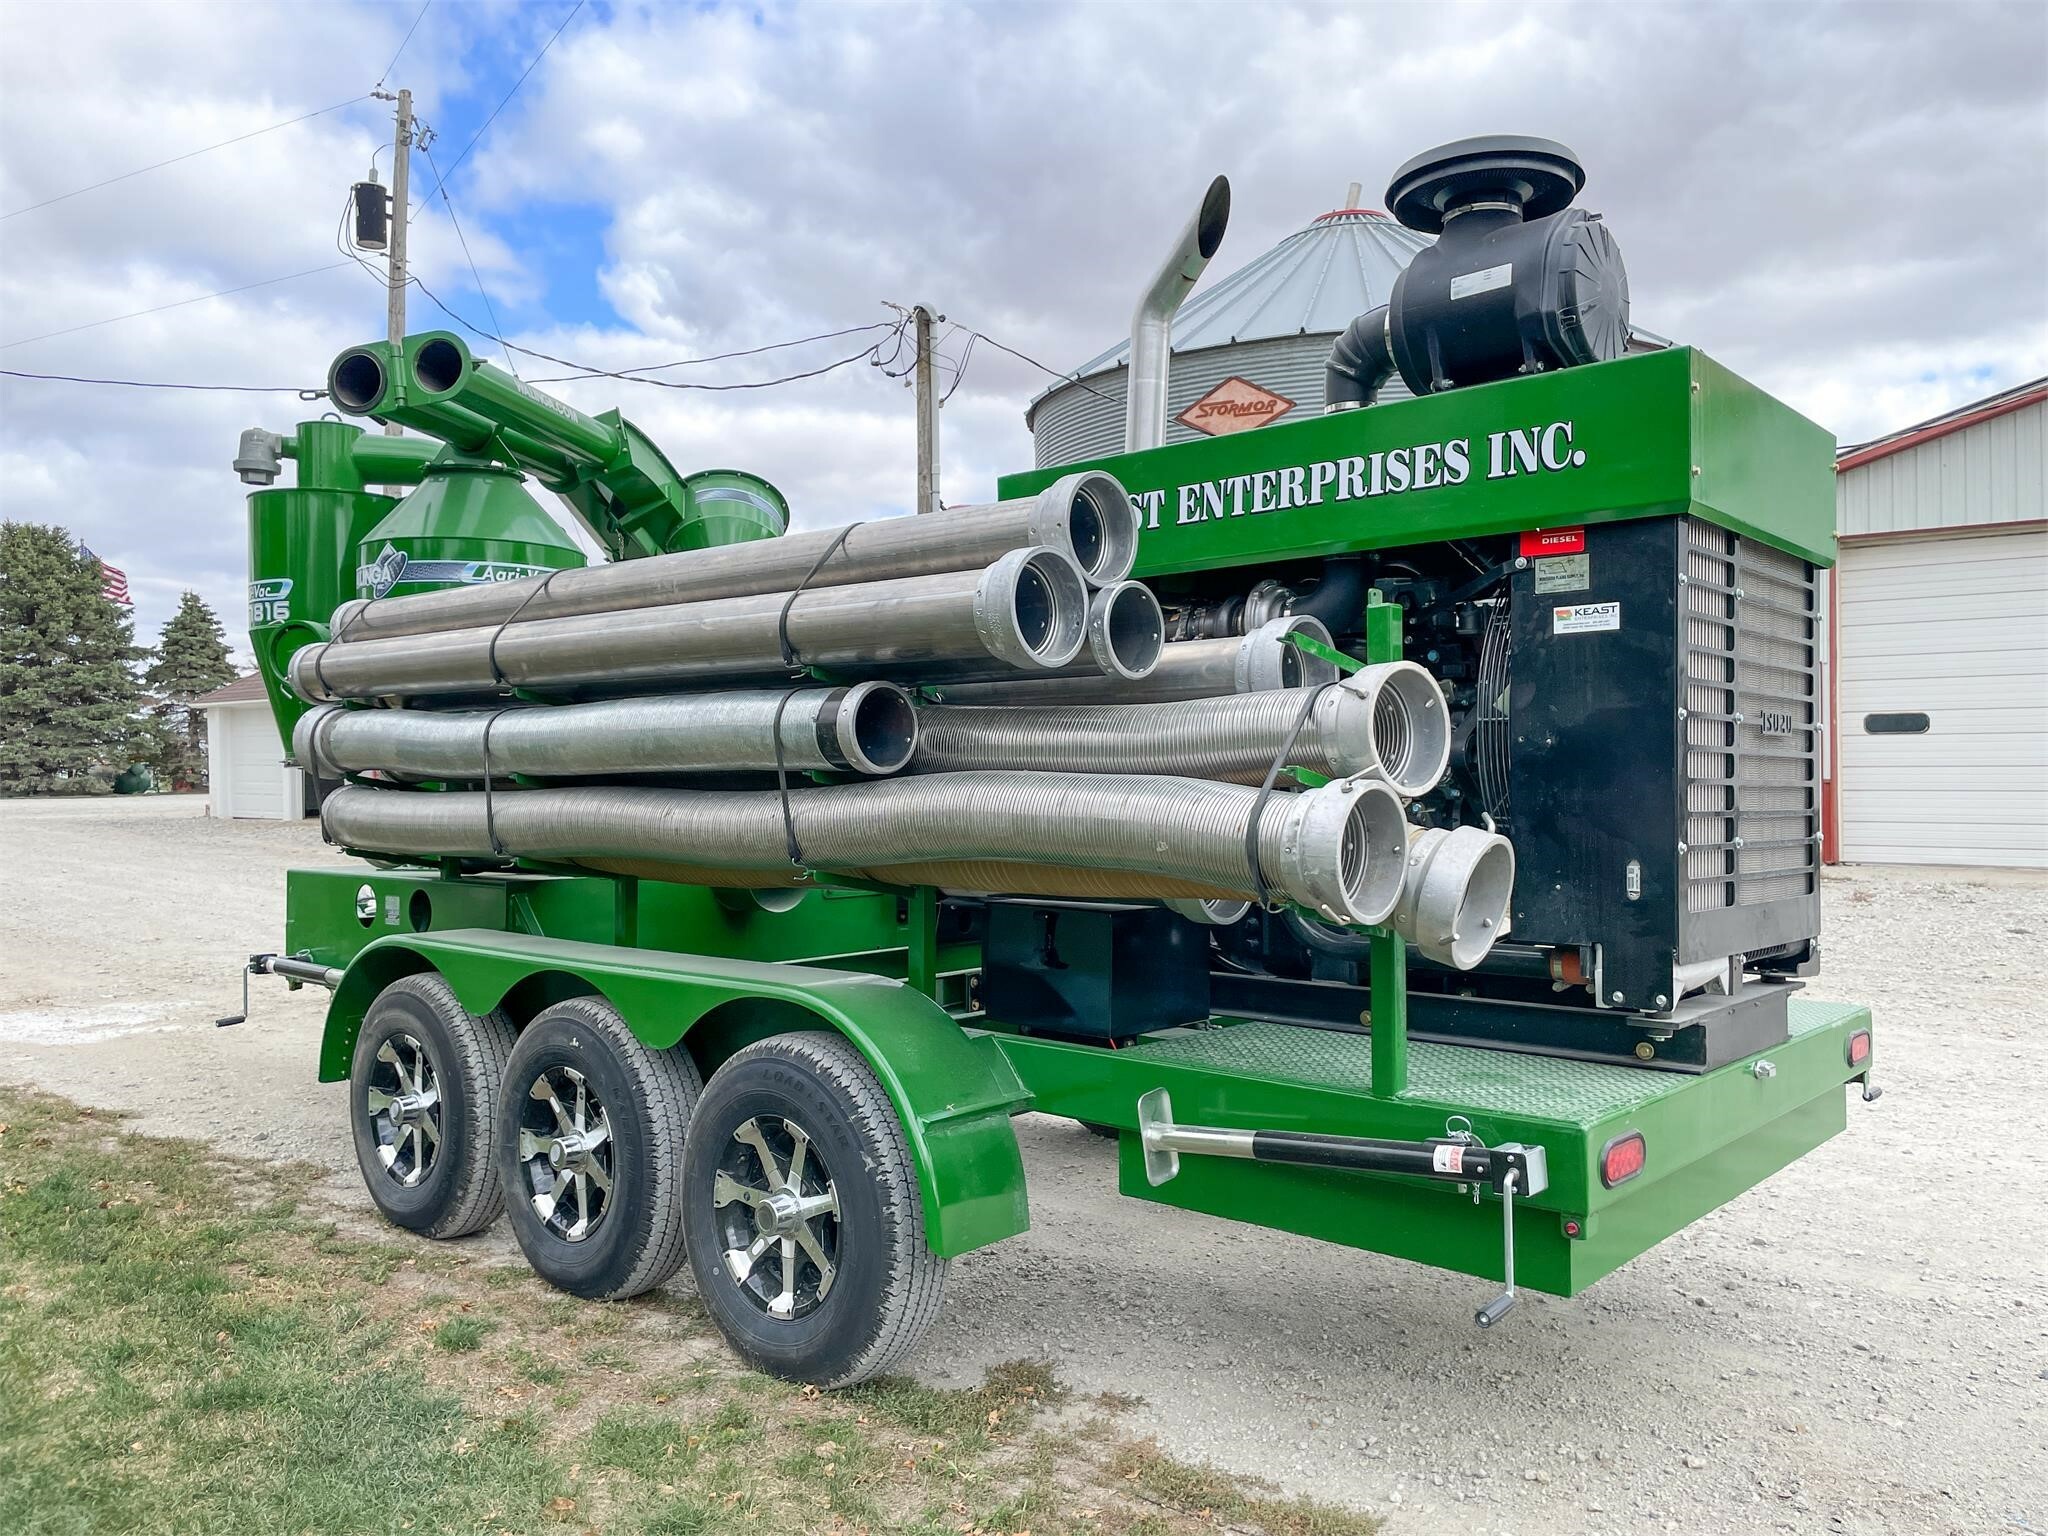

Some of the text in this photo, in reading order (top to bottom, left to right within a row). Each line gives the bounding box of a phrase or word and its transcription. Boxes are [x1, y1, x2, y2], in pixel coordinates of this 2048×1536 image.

[1195, 400, 1278, 418] STORMOR
[1176, 438, 1471, 525] ENTERPRISES
[1486, 420, 1587, 480] INC.
[1542, 535, 1578, 544] DIESEL
[1574, 605, 1618, 616] KEAST
[1761, 711, 1792, 734] ISUZU
